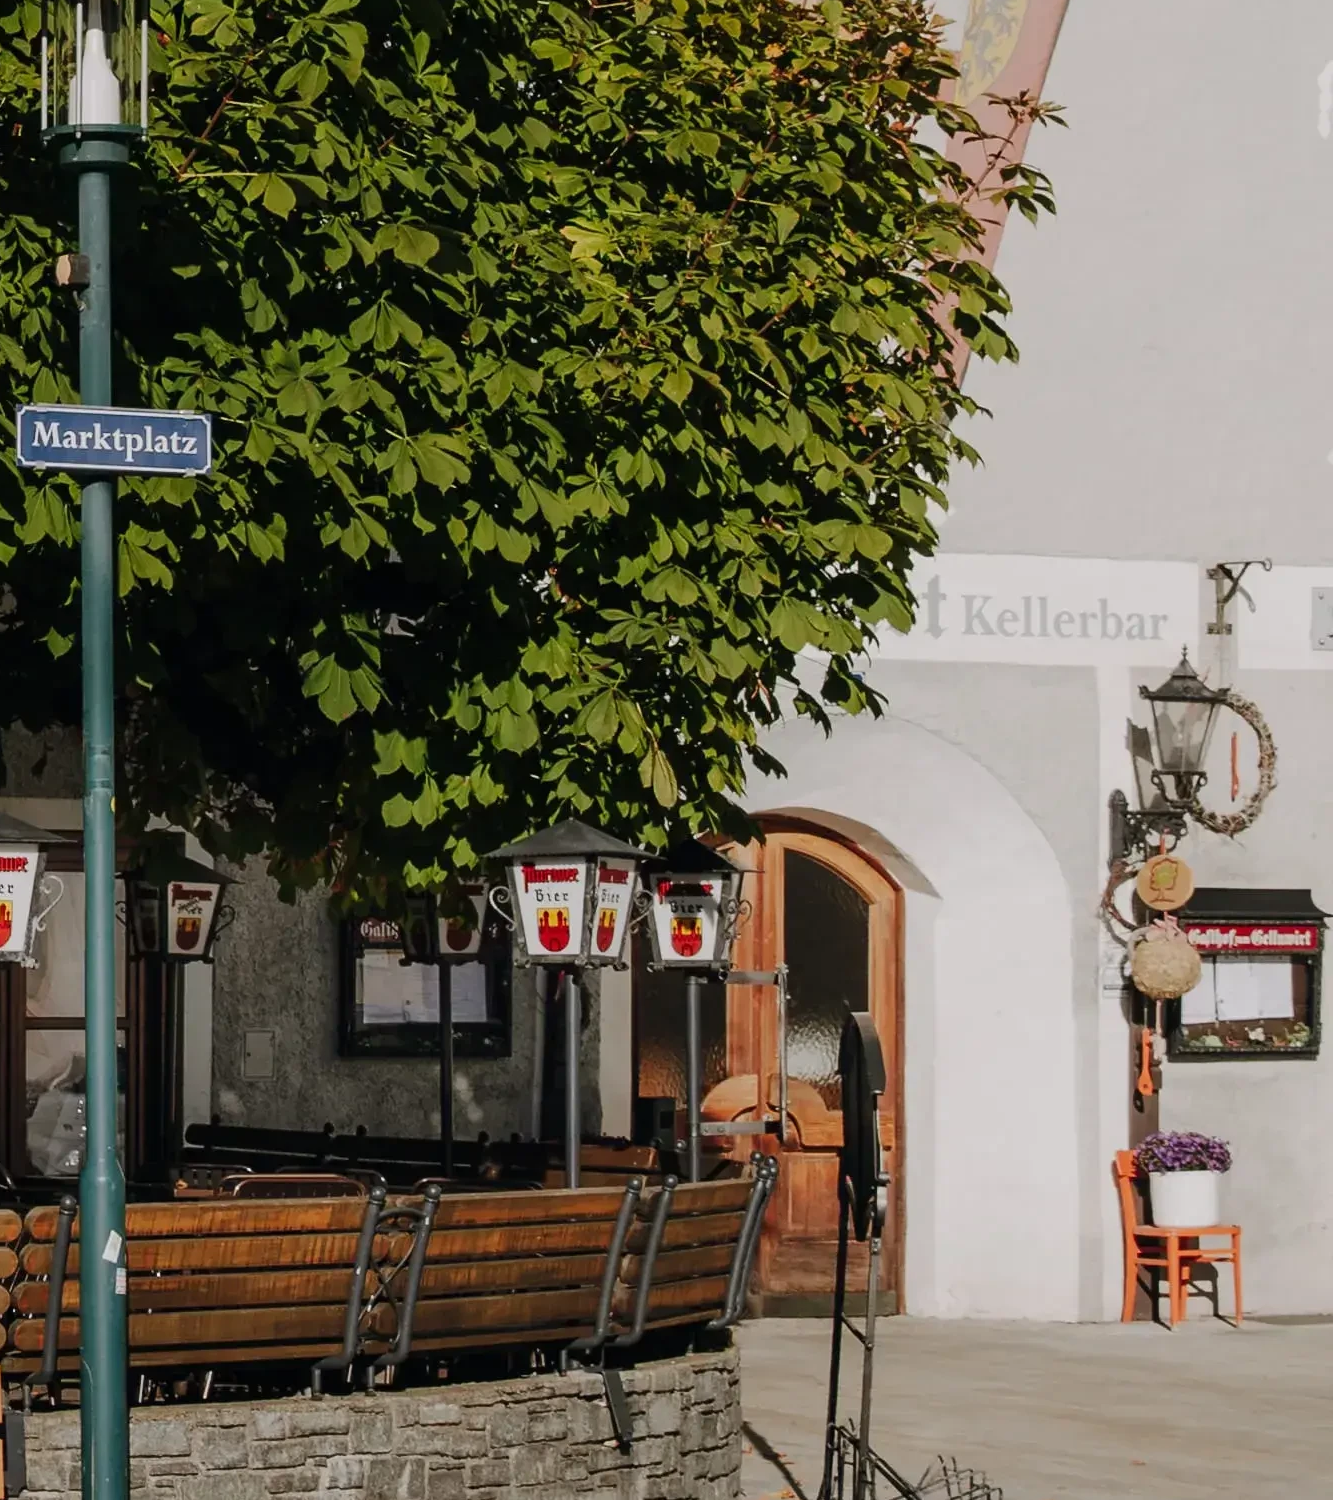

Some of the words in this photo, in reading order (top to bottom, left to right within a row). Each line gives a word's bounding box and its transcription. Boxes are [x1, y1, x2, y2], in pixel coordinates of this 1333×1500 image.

[31, 420, 198, 463] Marktplatz
[960, 594, 1169, 641] Kellerbar
[535, 888, 570, 902] Bier
[669, 900, 703, 913] Bier
